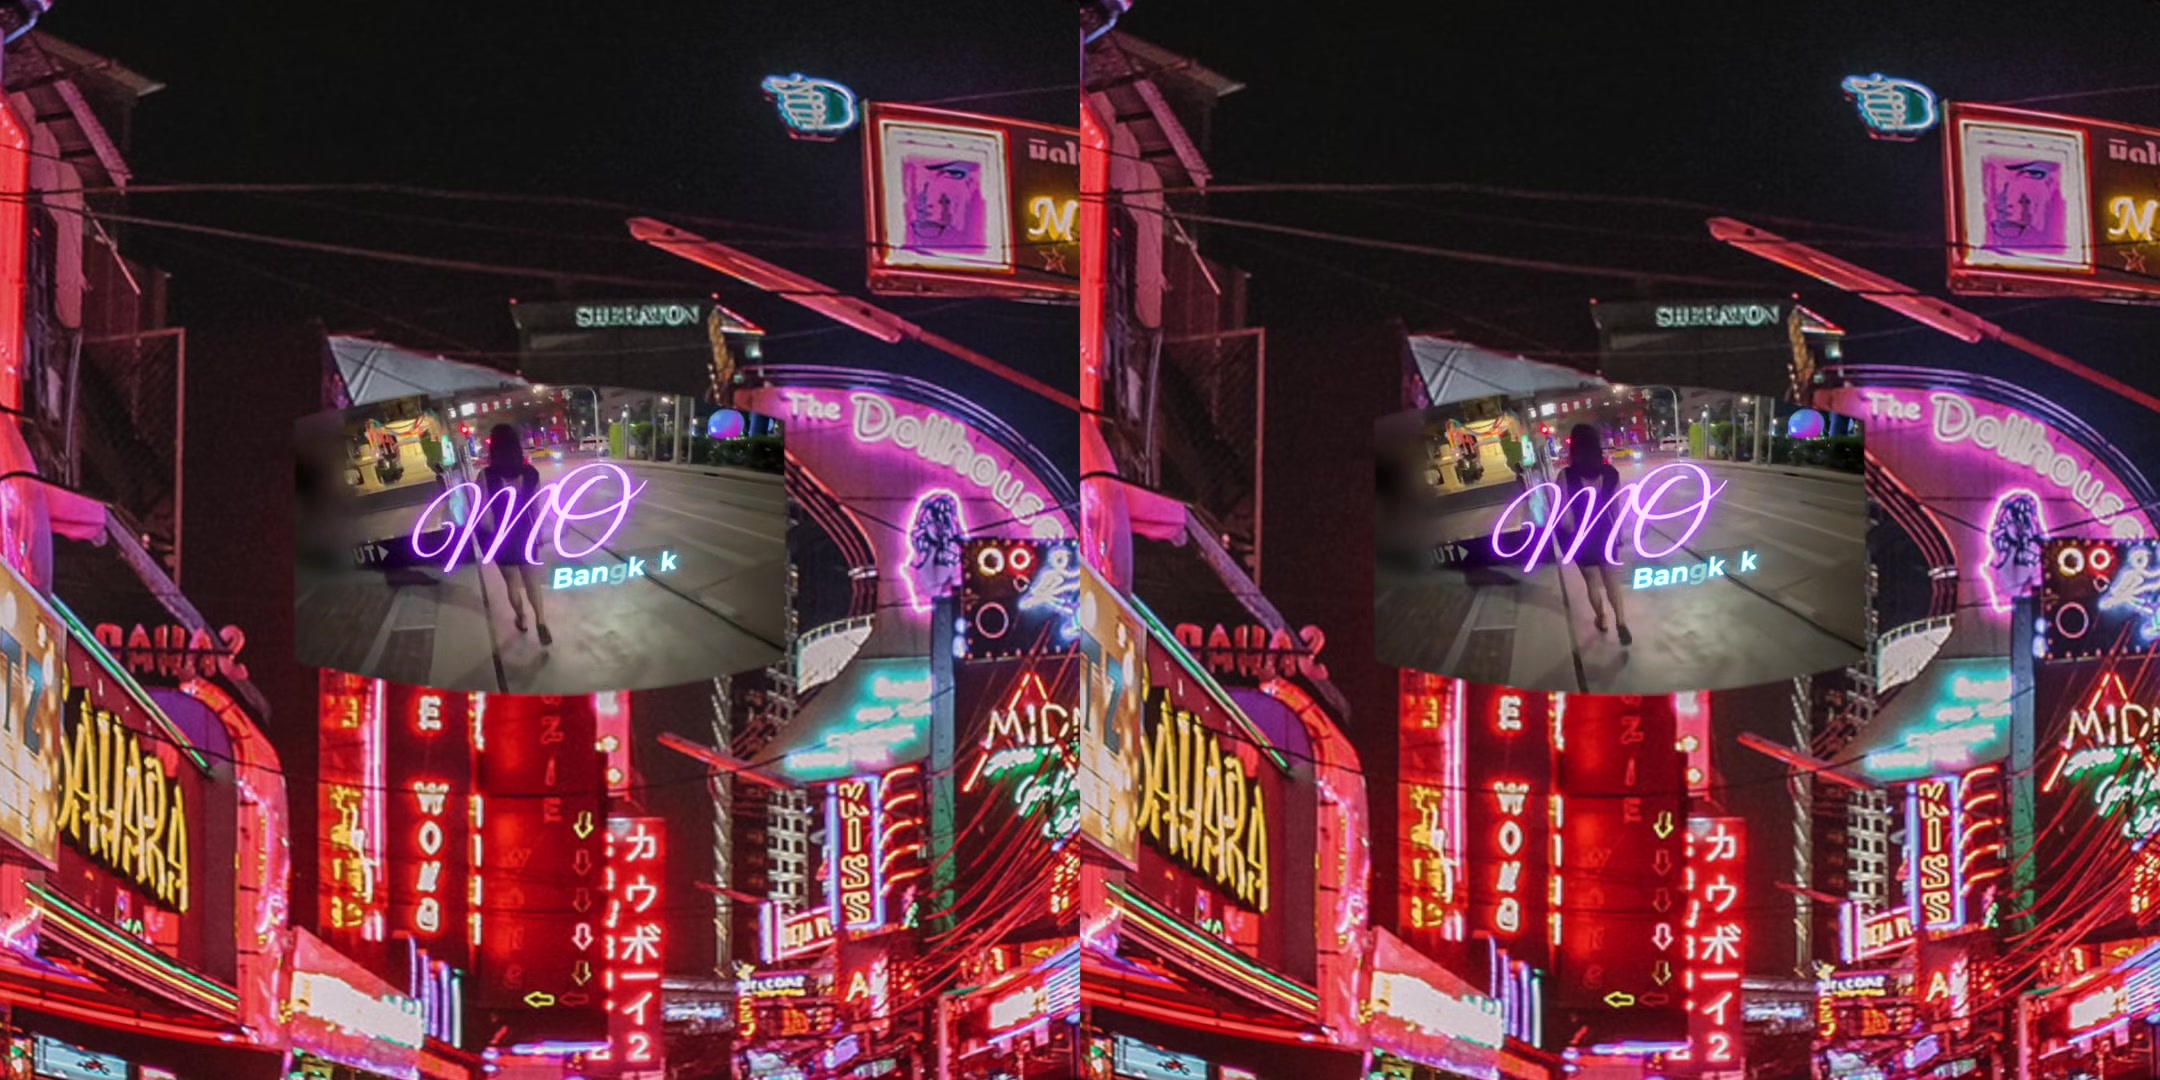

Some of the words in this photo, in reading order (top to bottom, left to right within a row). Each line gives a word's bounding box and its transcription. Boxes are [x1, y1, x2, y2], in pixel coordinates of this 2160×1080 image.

[576, 304, 699, 328] SHERATON
[1656, 304, 1779, 328] SHERATON
[785, 391, 842, 421] The
[1865, 391, 1922, 421] The
[620, 823, 662, 1061] カウボーイ2
[1700, 823, 1742, 1061] カウボーイ2
